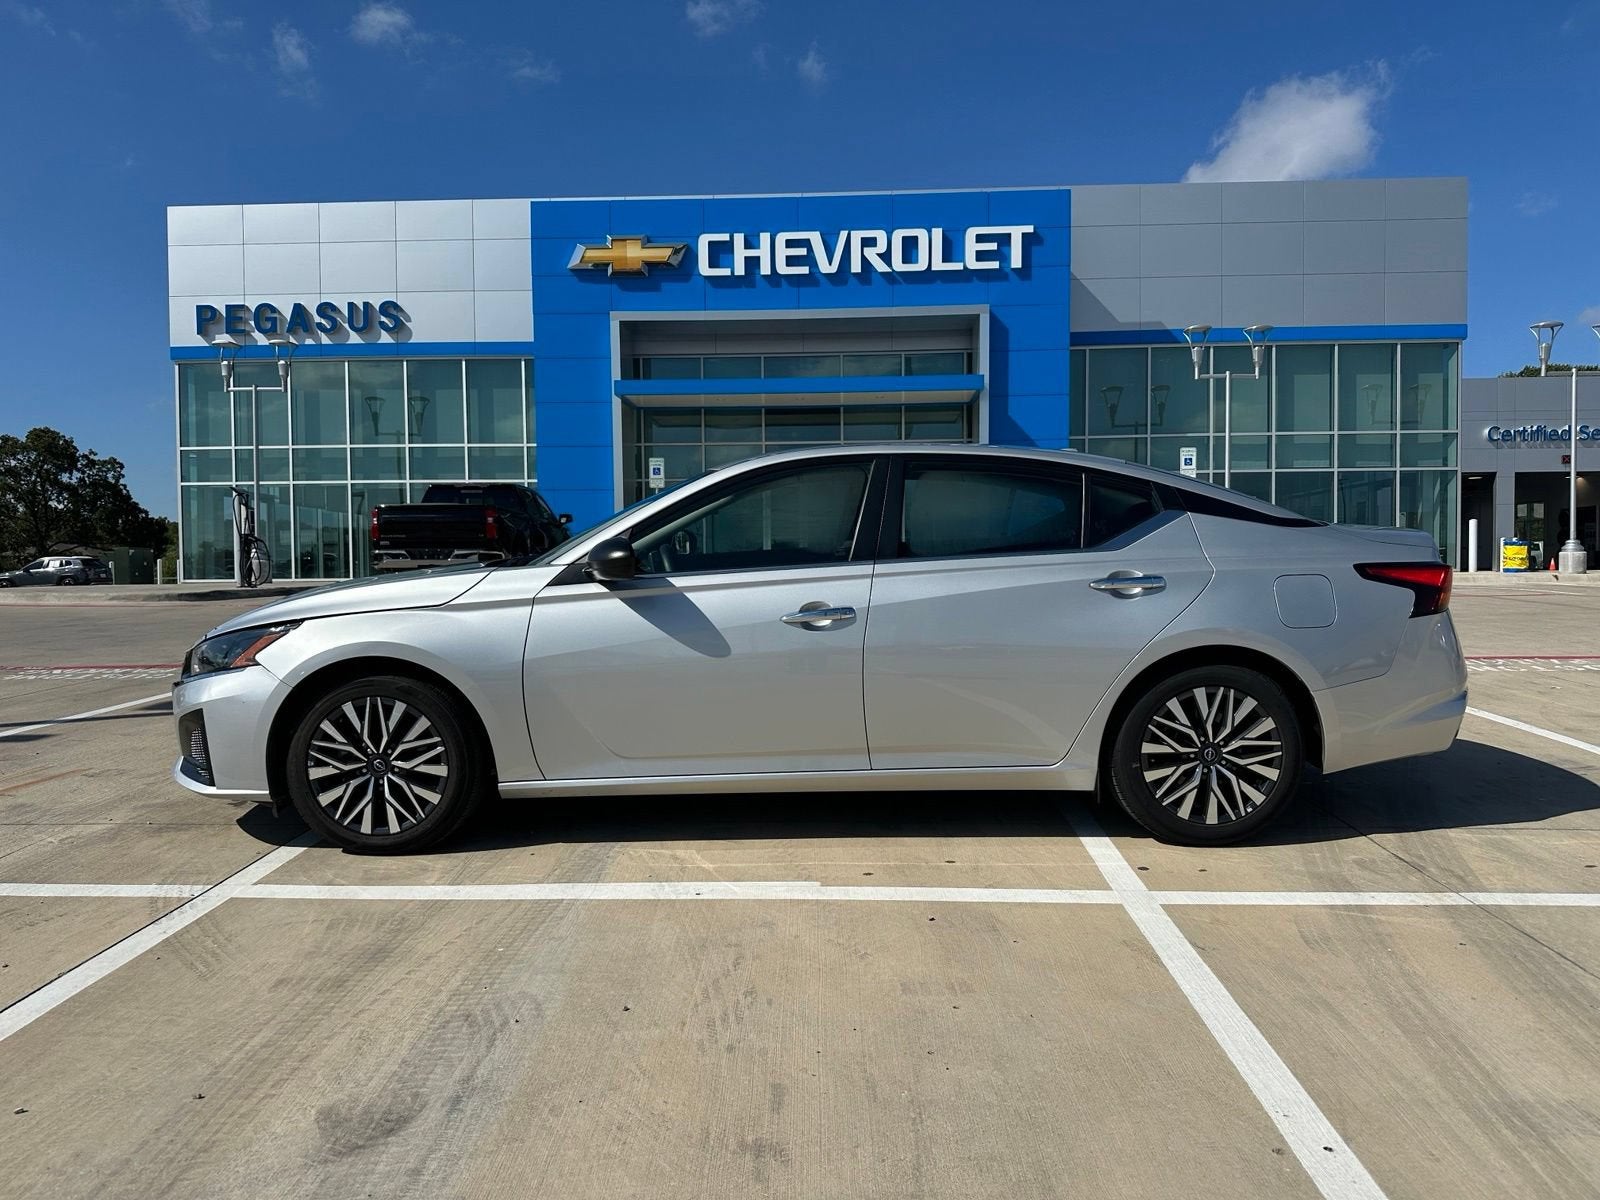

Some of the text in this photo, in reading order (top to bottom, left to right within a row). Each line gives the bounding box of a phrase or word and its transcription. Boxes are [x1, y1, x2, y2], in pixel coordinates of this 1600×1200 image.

[699, 225, 1035, 276] CHEVROLET
[195, 300, 401, 335] PEGASUS
[1487, 425, 1572, 442] Certified
